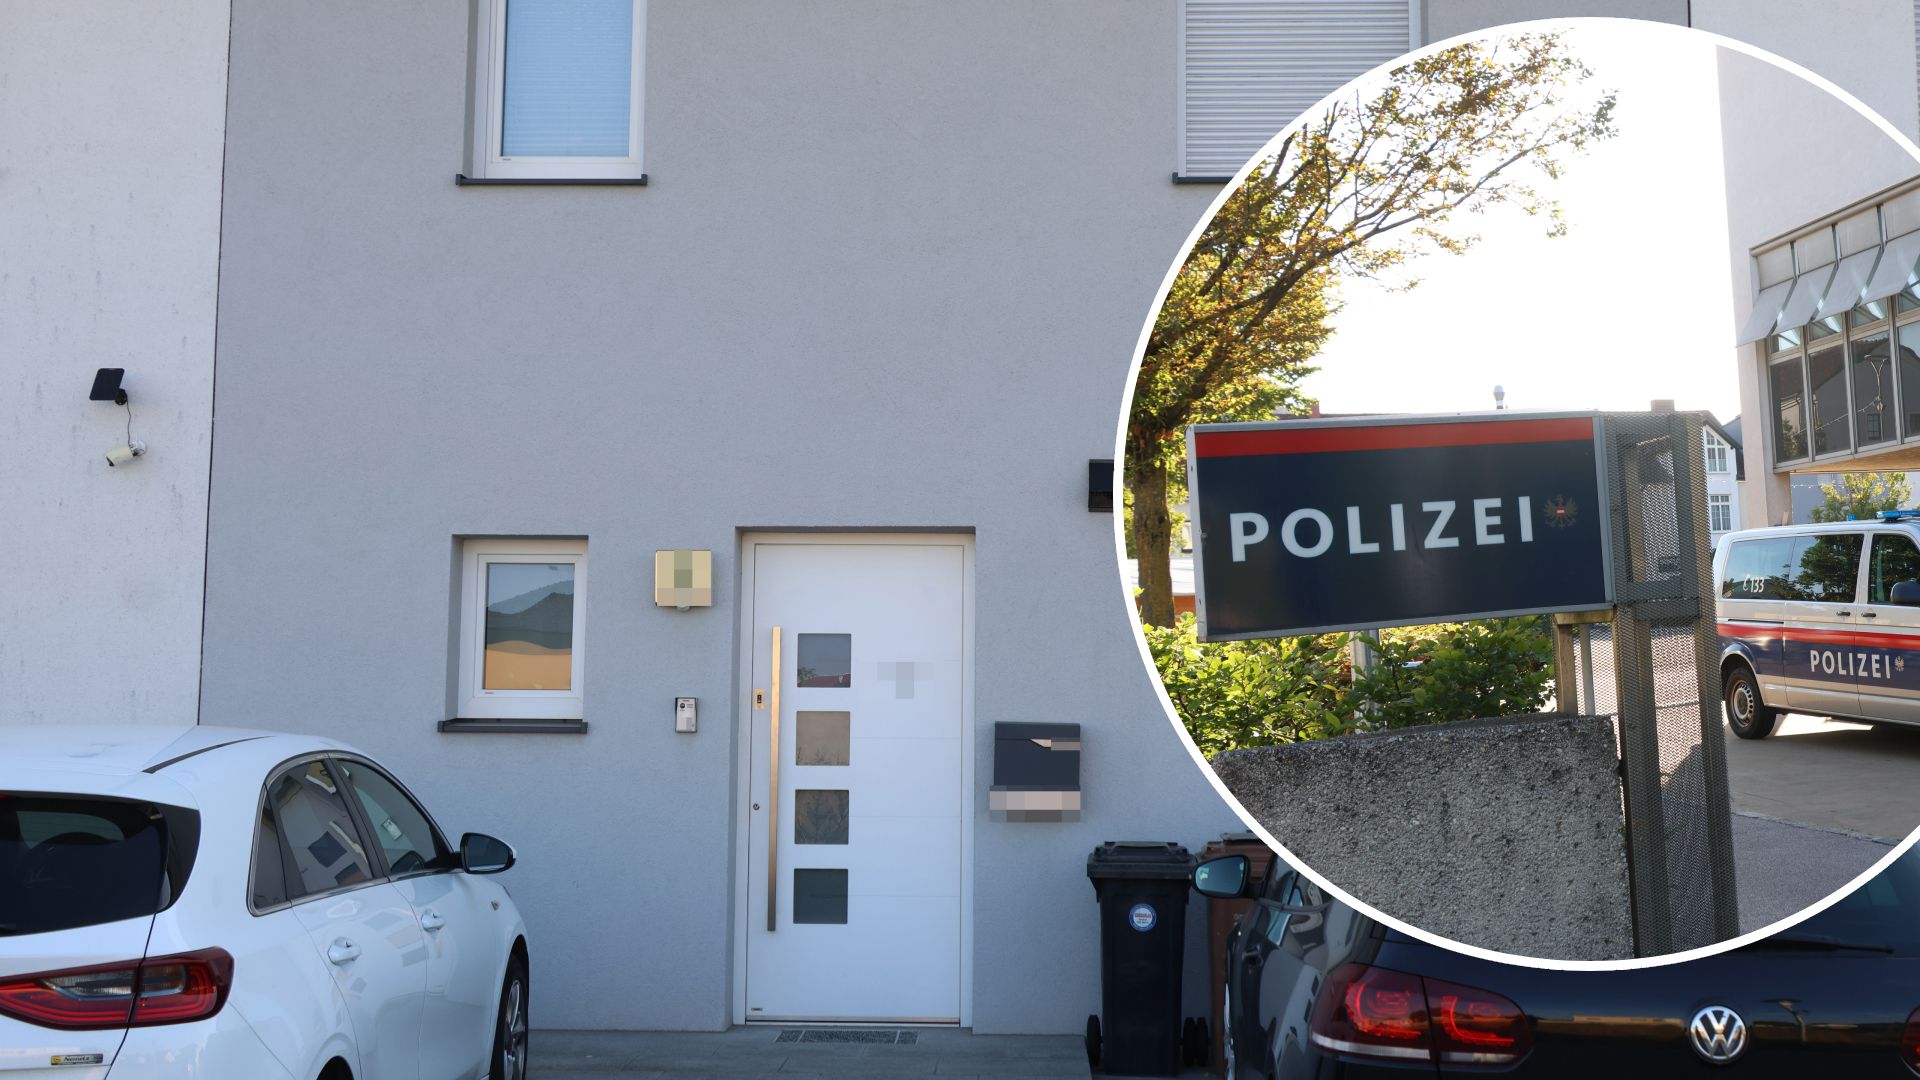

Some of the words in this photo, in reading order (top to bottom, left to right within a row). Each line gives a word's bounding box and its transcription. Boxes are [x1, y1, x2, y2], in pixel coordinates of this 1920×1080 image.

[1229, 495, 1534, 562] POLIZEI
[1750, 576, 1765, 593] 133
[1810, 650, 1891, 679] POLIZEI
